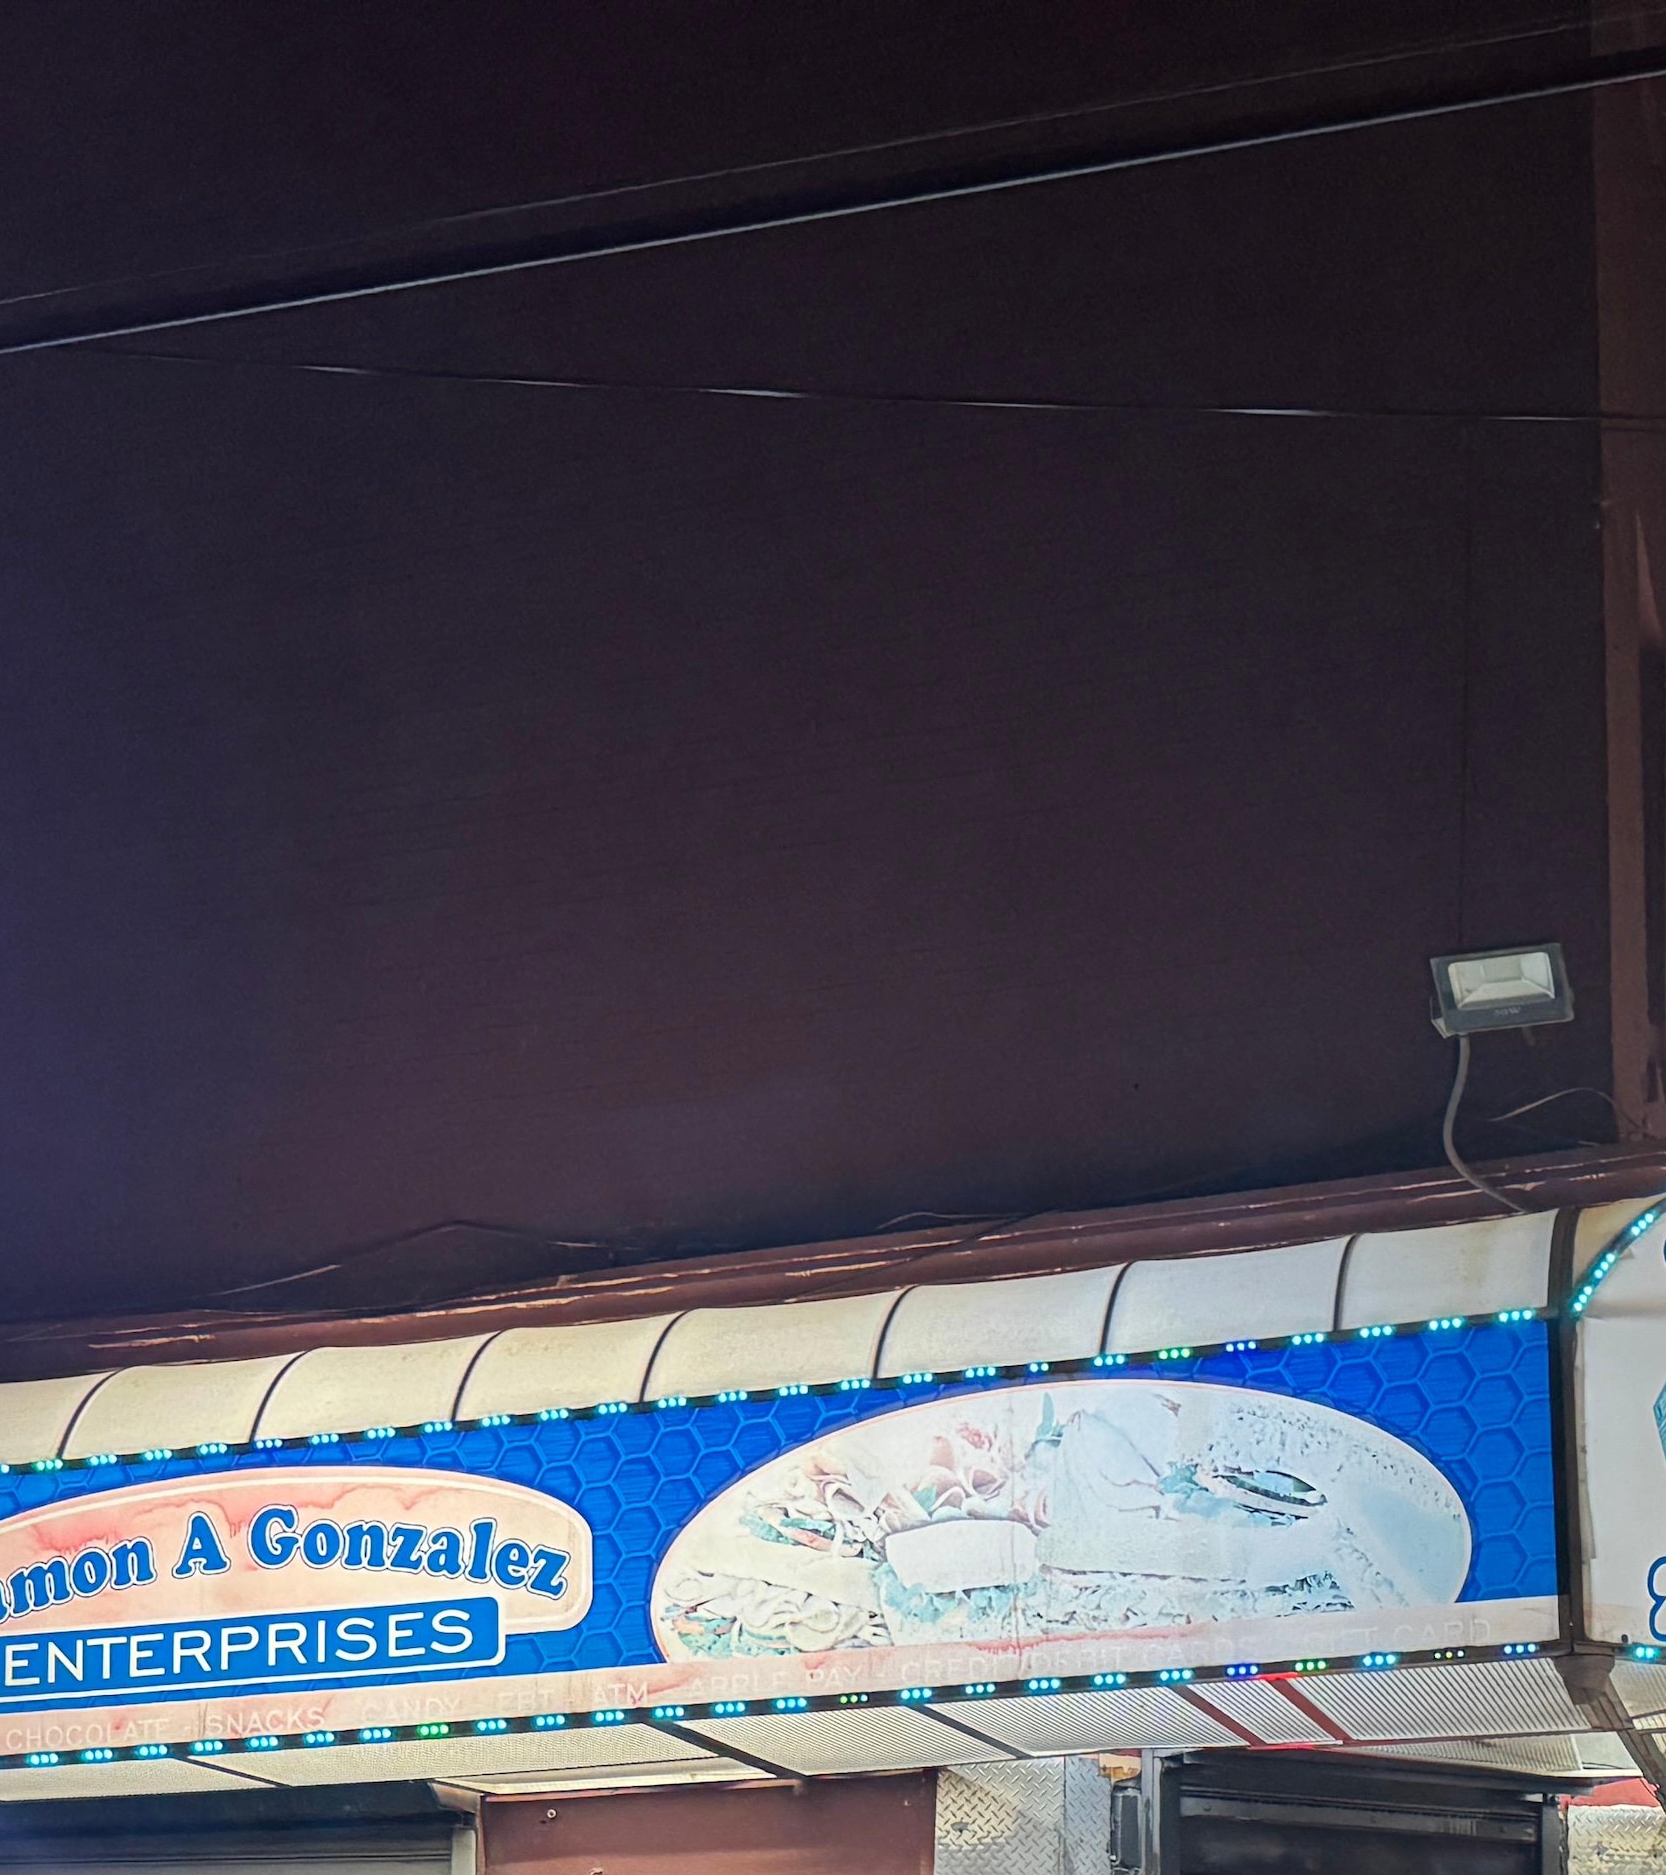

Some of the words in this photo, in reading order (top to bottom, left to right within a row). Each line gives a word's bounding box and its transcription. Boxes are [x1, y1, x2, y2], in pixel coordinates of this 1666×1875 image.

[174, 1511, 232, 1580] A
[248, 1503, 573, 1601] Gonzalez
[3, 1608, 475, 1689] ENTERPRISES
[4, 1718, 169, 1751] CHOCOLATE
[206, 1706, 326, 1735] SNACKS
[363, 1697, 460, 1722] CANDY
[593, 1682, 649, 1707] ATM
[807, 1665, 863, 1690] PAY
[1391, 1618, 1492, 1647] CARD
